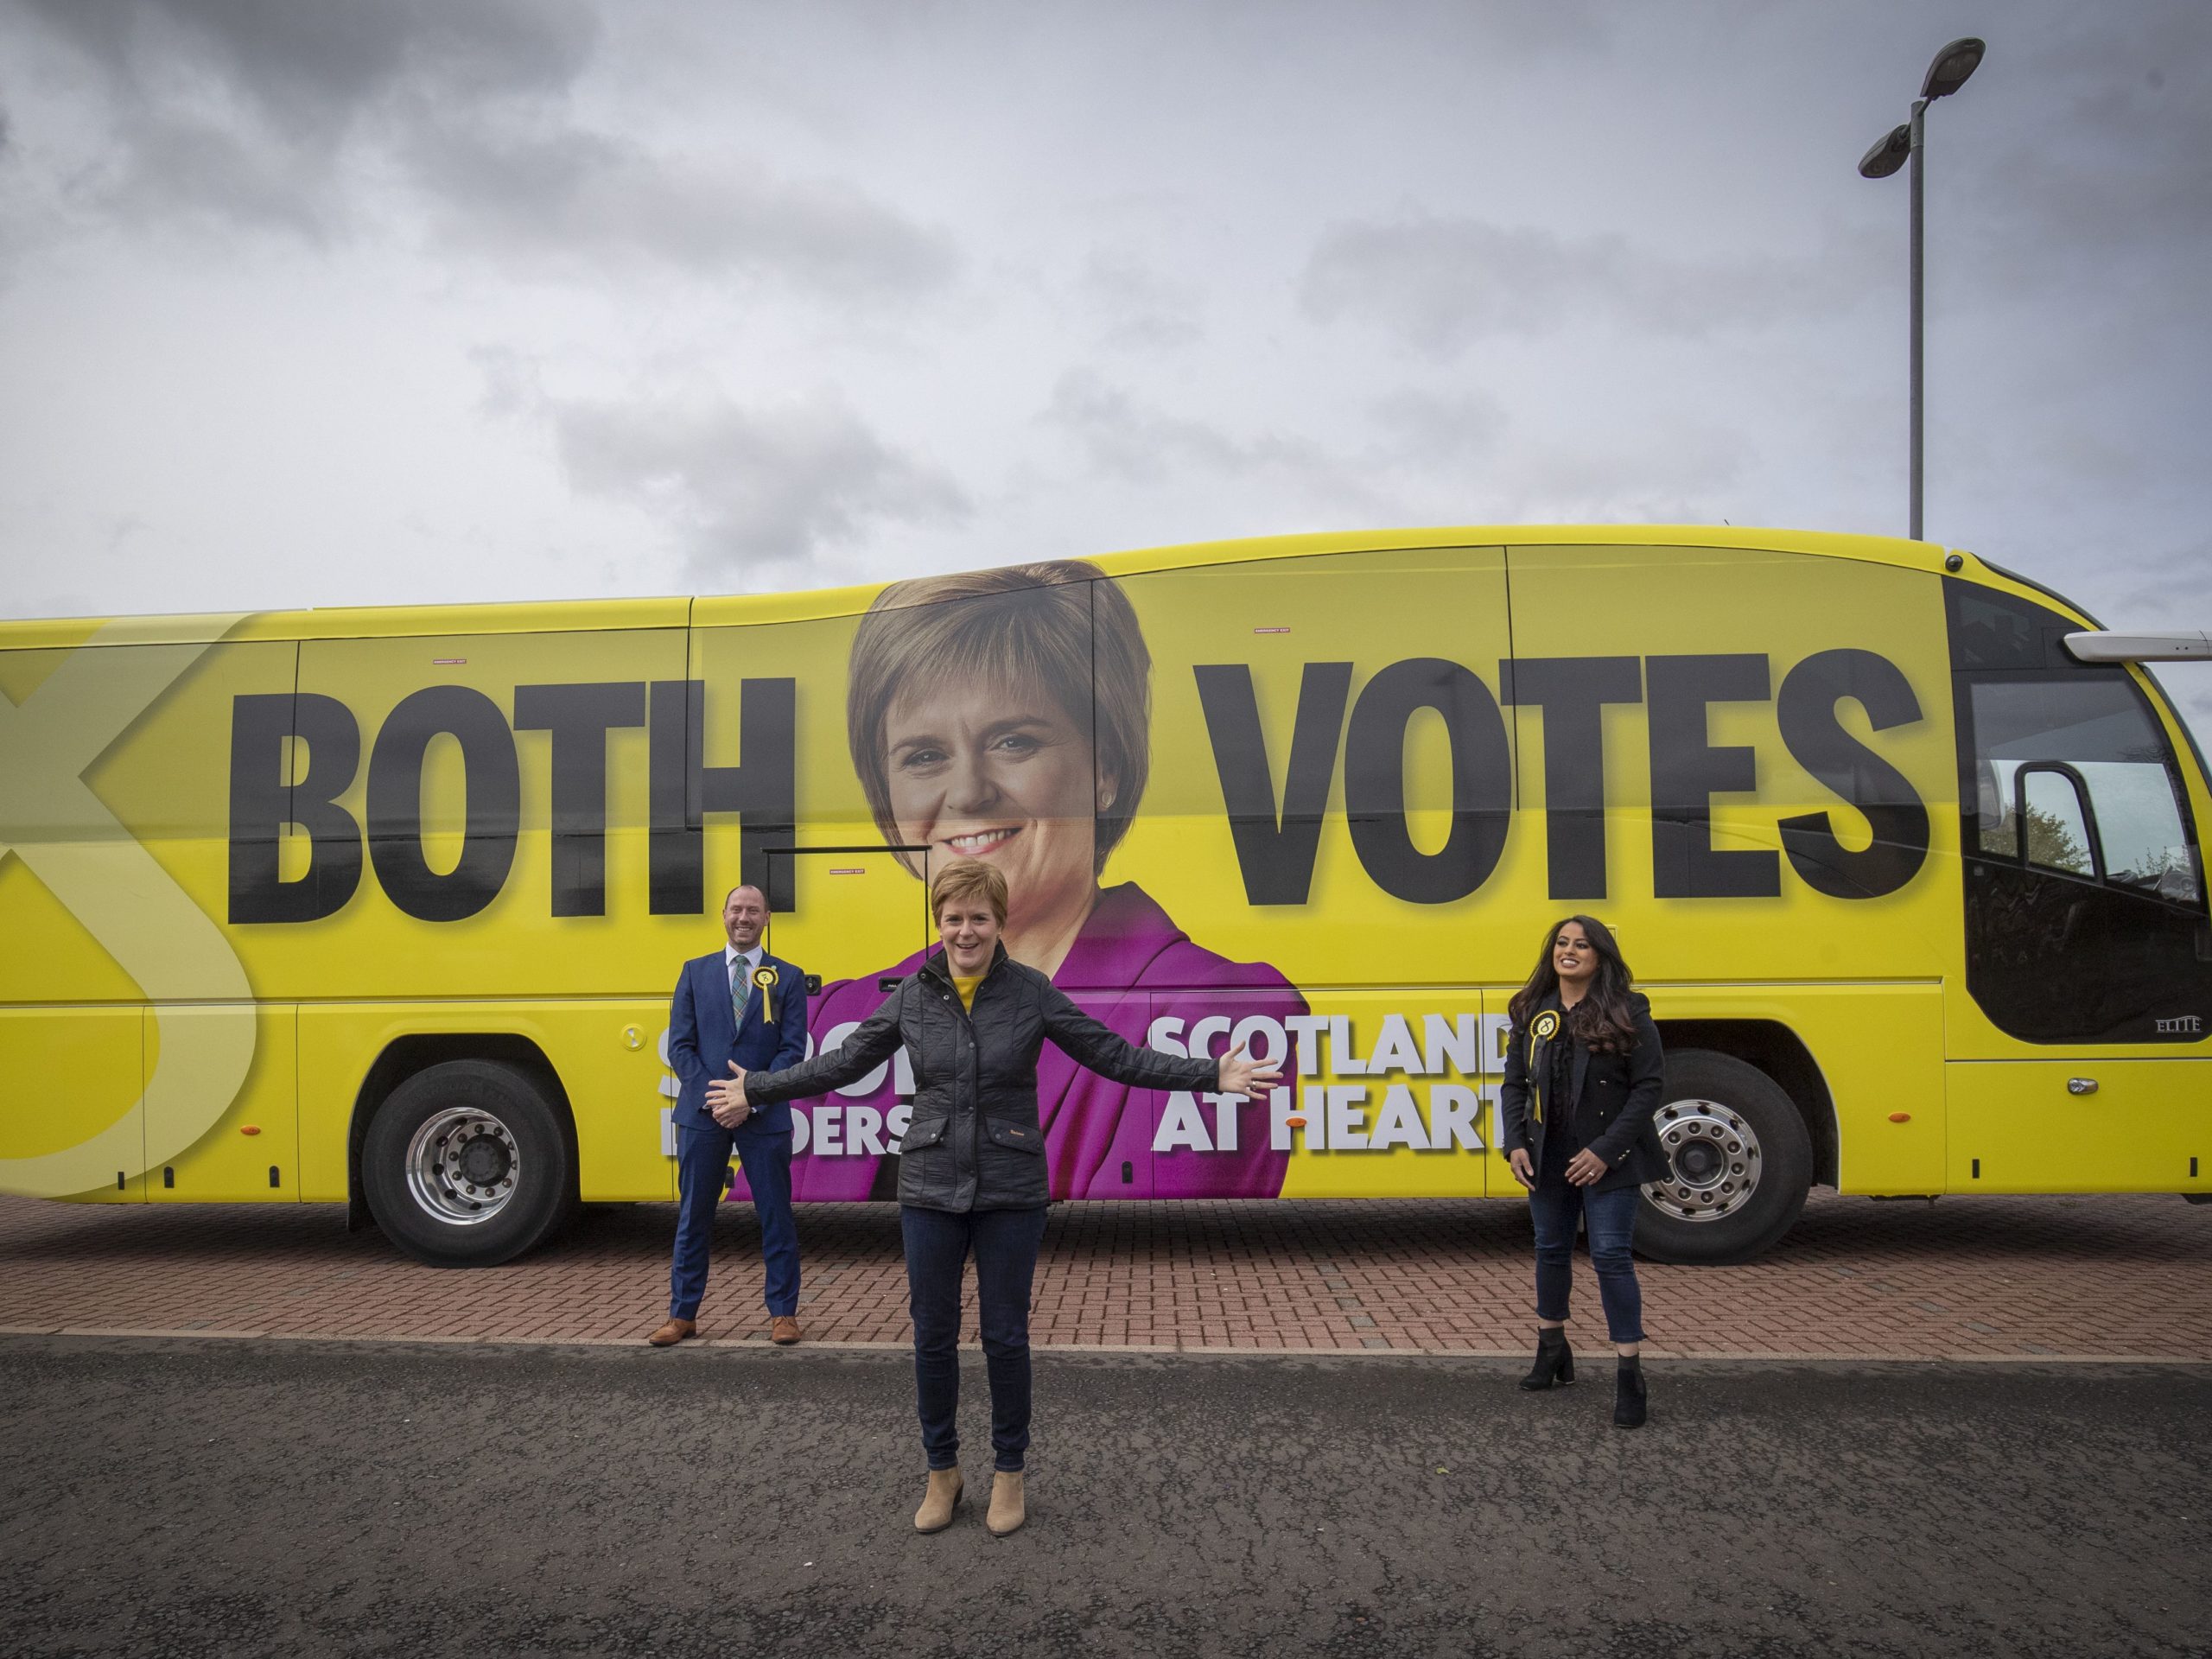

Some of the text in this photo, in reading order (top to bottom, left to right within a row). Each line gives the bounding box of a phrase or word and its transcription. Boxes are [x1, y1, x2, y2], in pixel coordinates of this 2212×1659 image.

[228, 677, 796, 925] BOTH
[1192, 648, 1930, 906] VOTES
[1147, 1014, 1510, 1075] SCOTLAND
[2157, 1016, 2201, 1032] ELITE
[1150, 1090, 1250, 1152] AT
